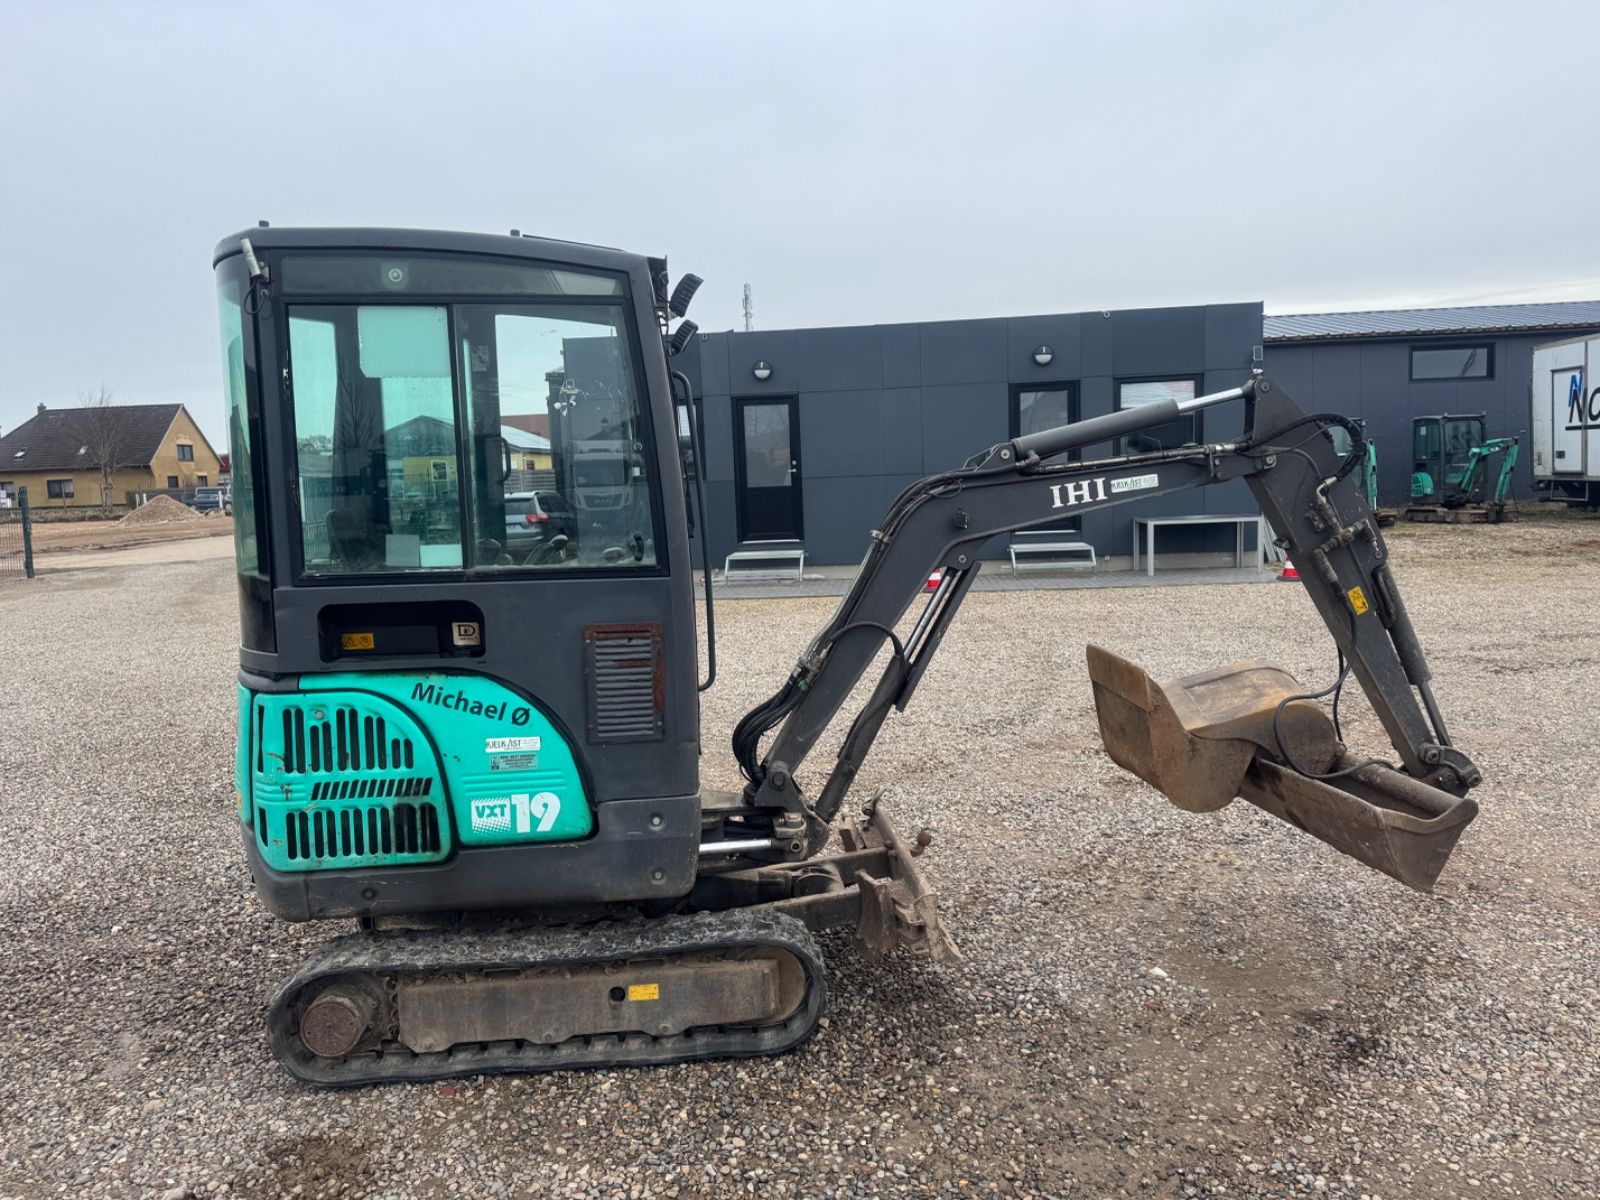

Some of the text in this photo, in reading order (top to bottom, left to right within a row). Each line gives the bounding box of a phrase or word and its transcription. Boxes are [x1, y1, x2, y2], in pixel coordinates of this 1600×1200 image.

[1049, 477, 1108, 508] IHI
[411, 682, 531, 726] Michael Ø
[475, 792, 561, 833] VXT 19
